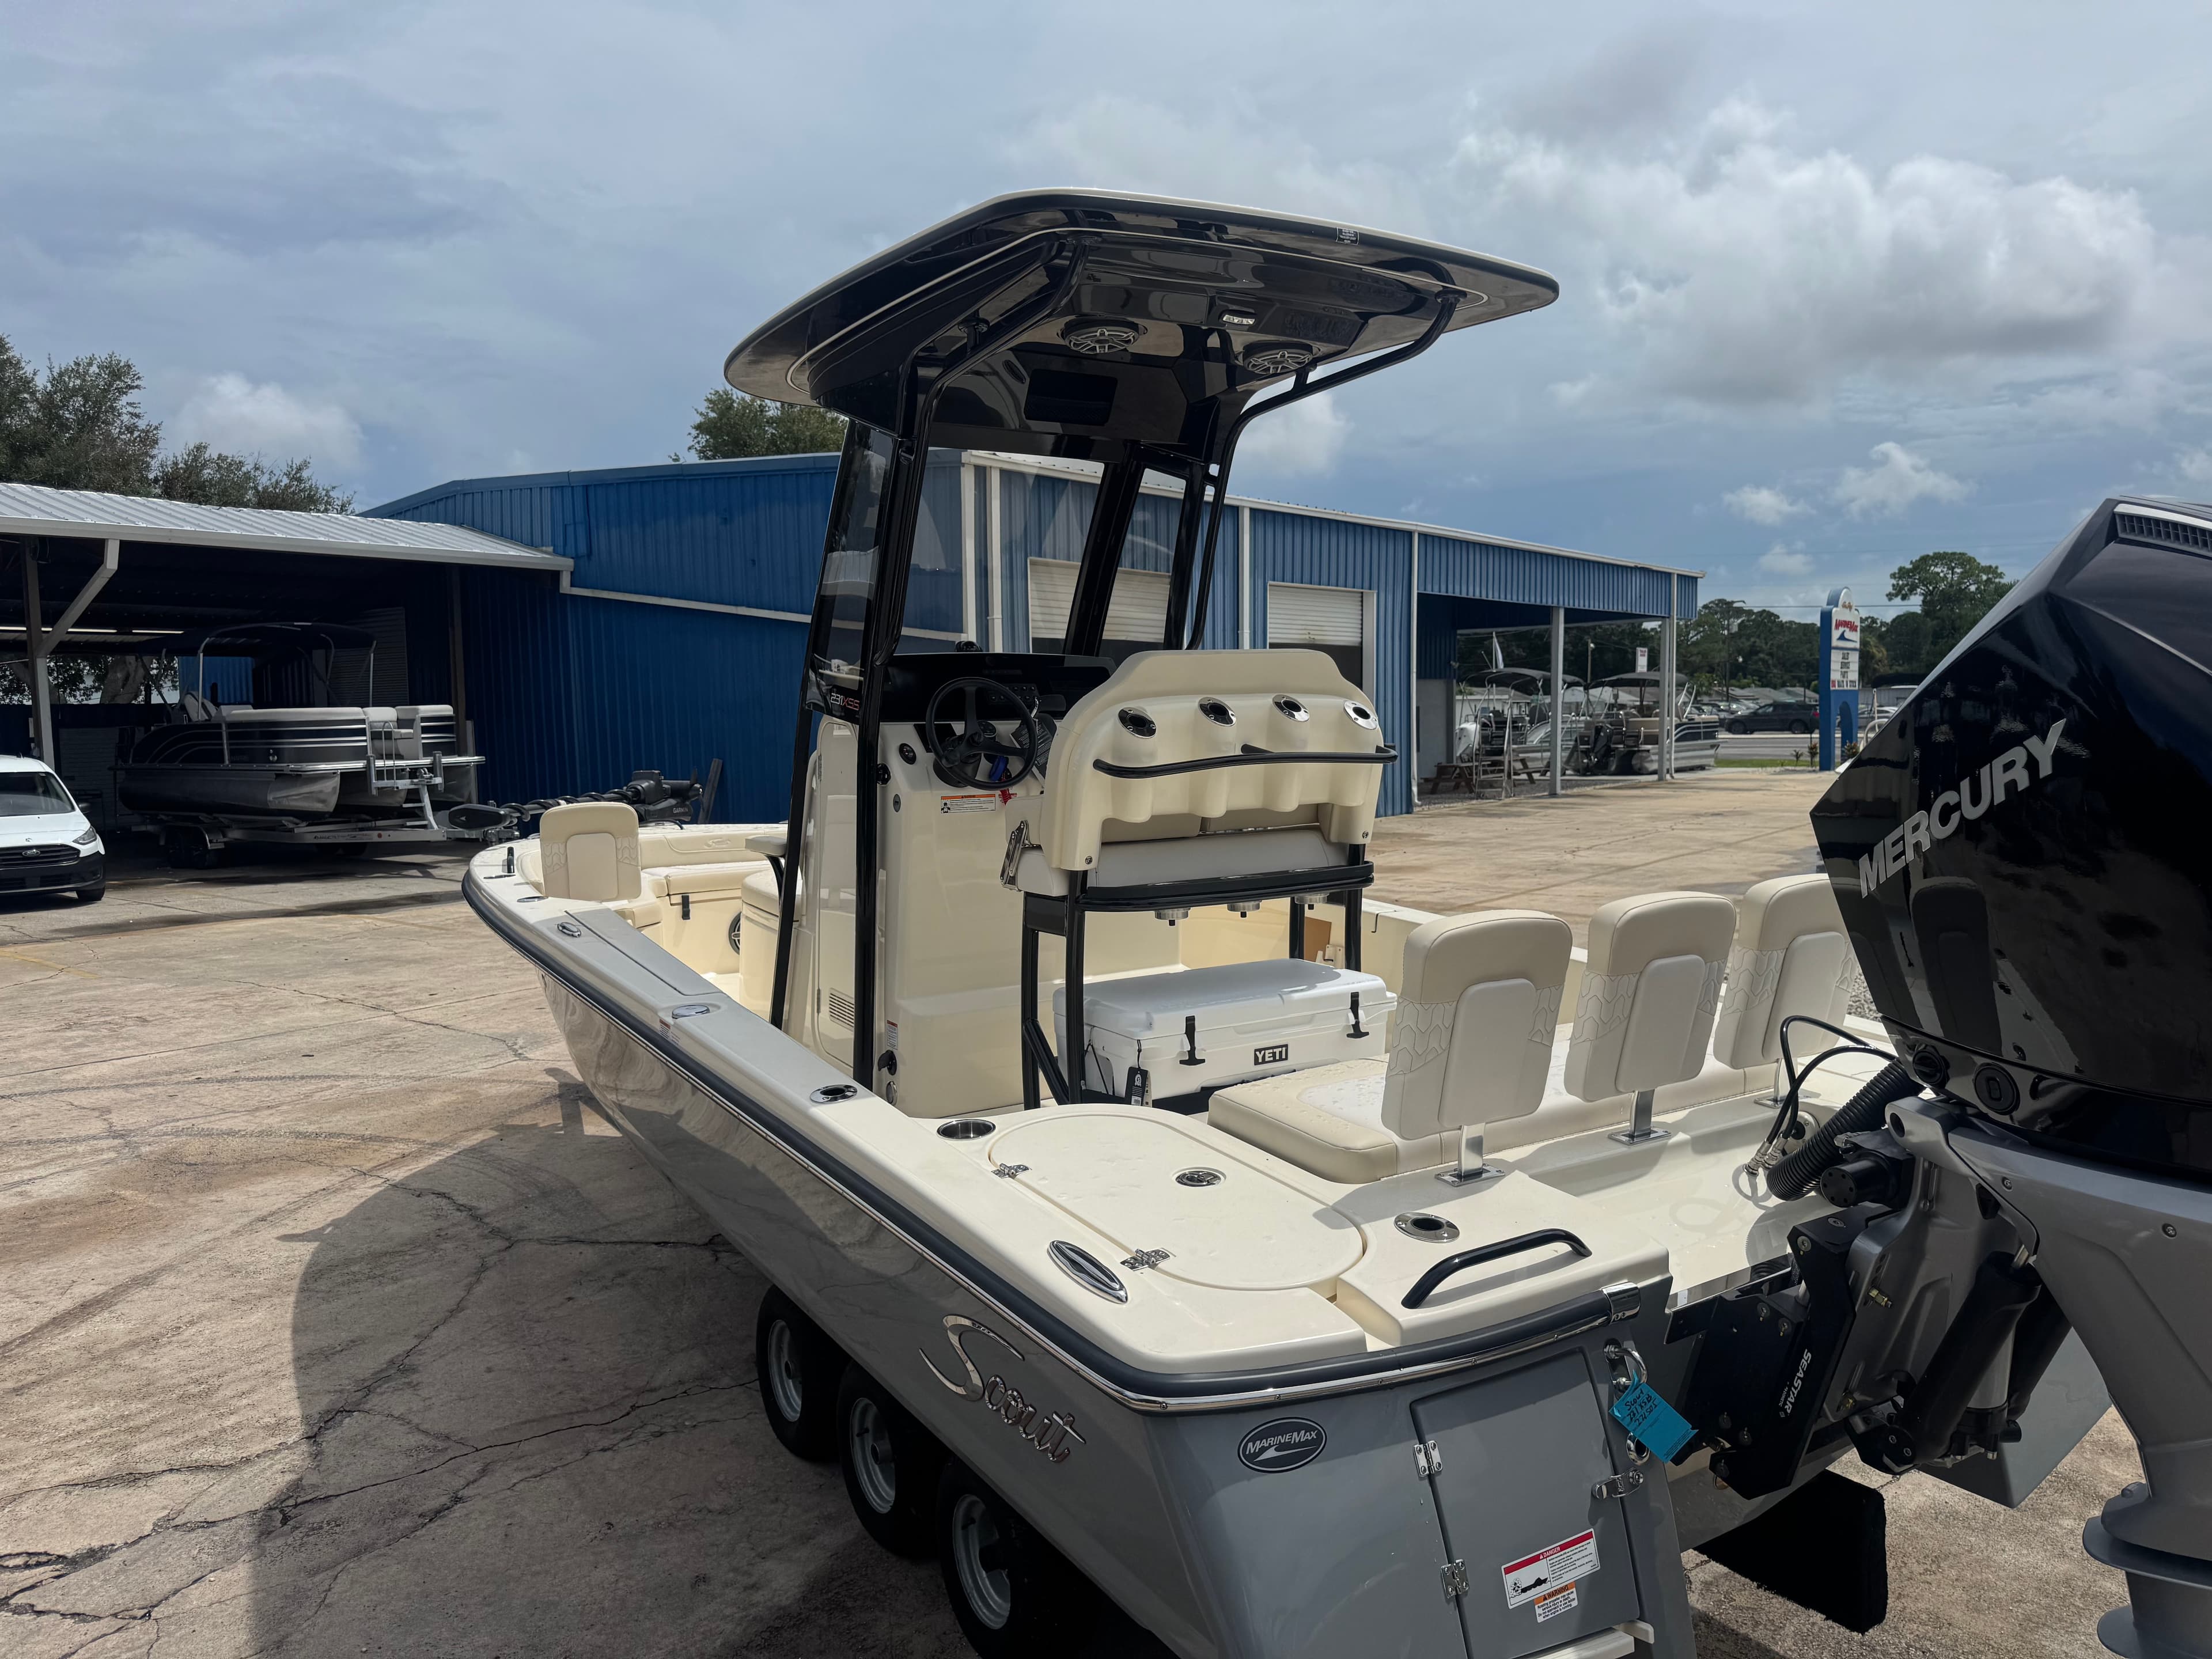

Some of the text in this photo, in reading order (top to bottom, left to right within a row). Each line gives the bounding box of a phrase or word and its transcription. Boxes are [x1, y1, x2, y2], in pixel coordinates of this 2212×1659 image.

[1858, 718, 2067, 899] MERCURY
[1255, 1047, 1286, 1063] YETI
[918, 1313, 1086, 1464] Scout
[1784, 1349, 1812, 1414] SEASTAR
[1624, 1389, 1644, 1410] Scout
[1543, 1547, 1560, 1557] DANGER
[1547, 1585, 1569, 1599] WARNING
